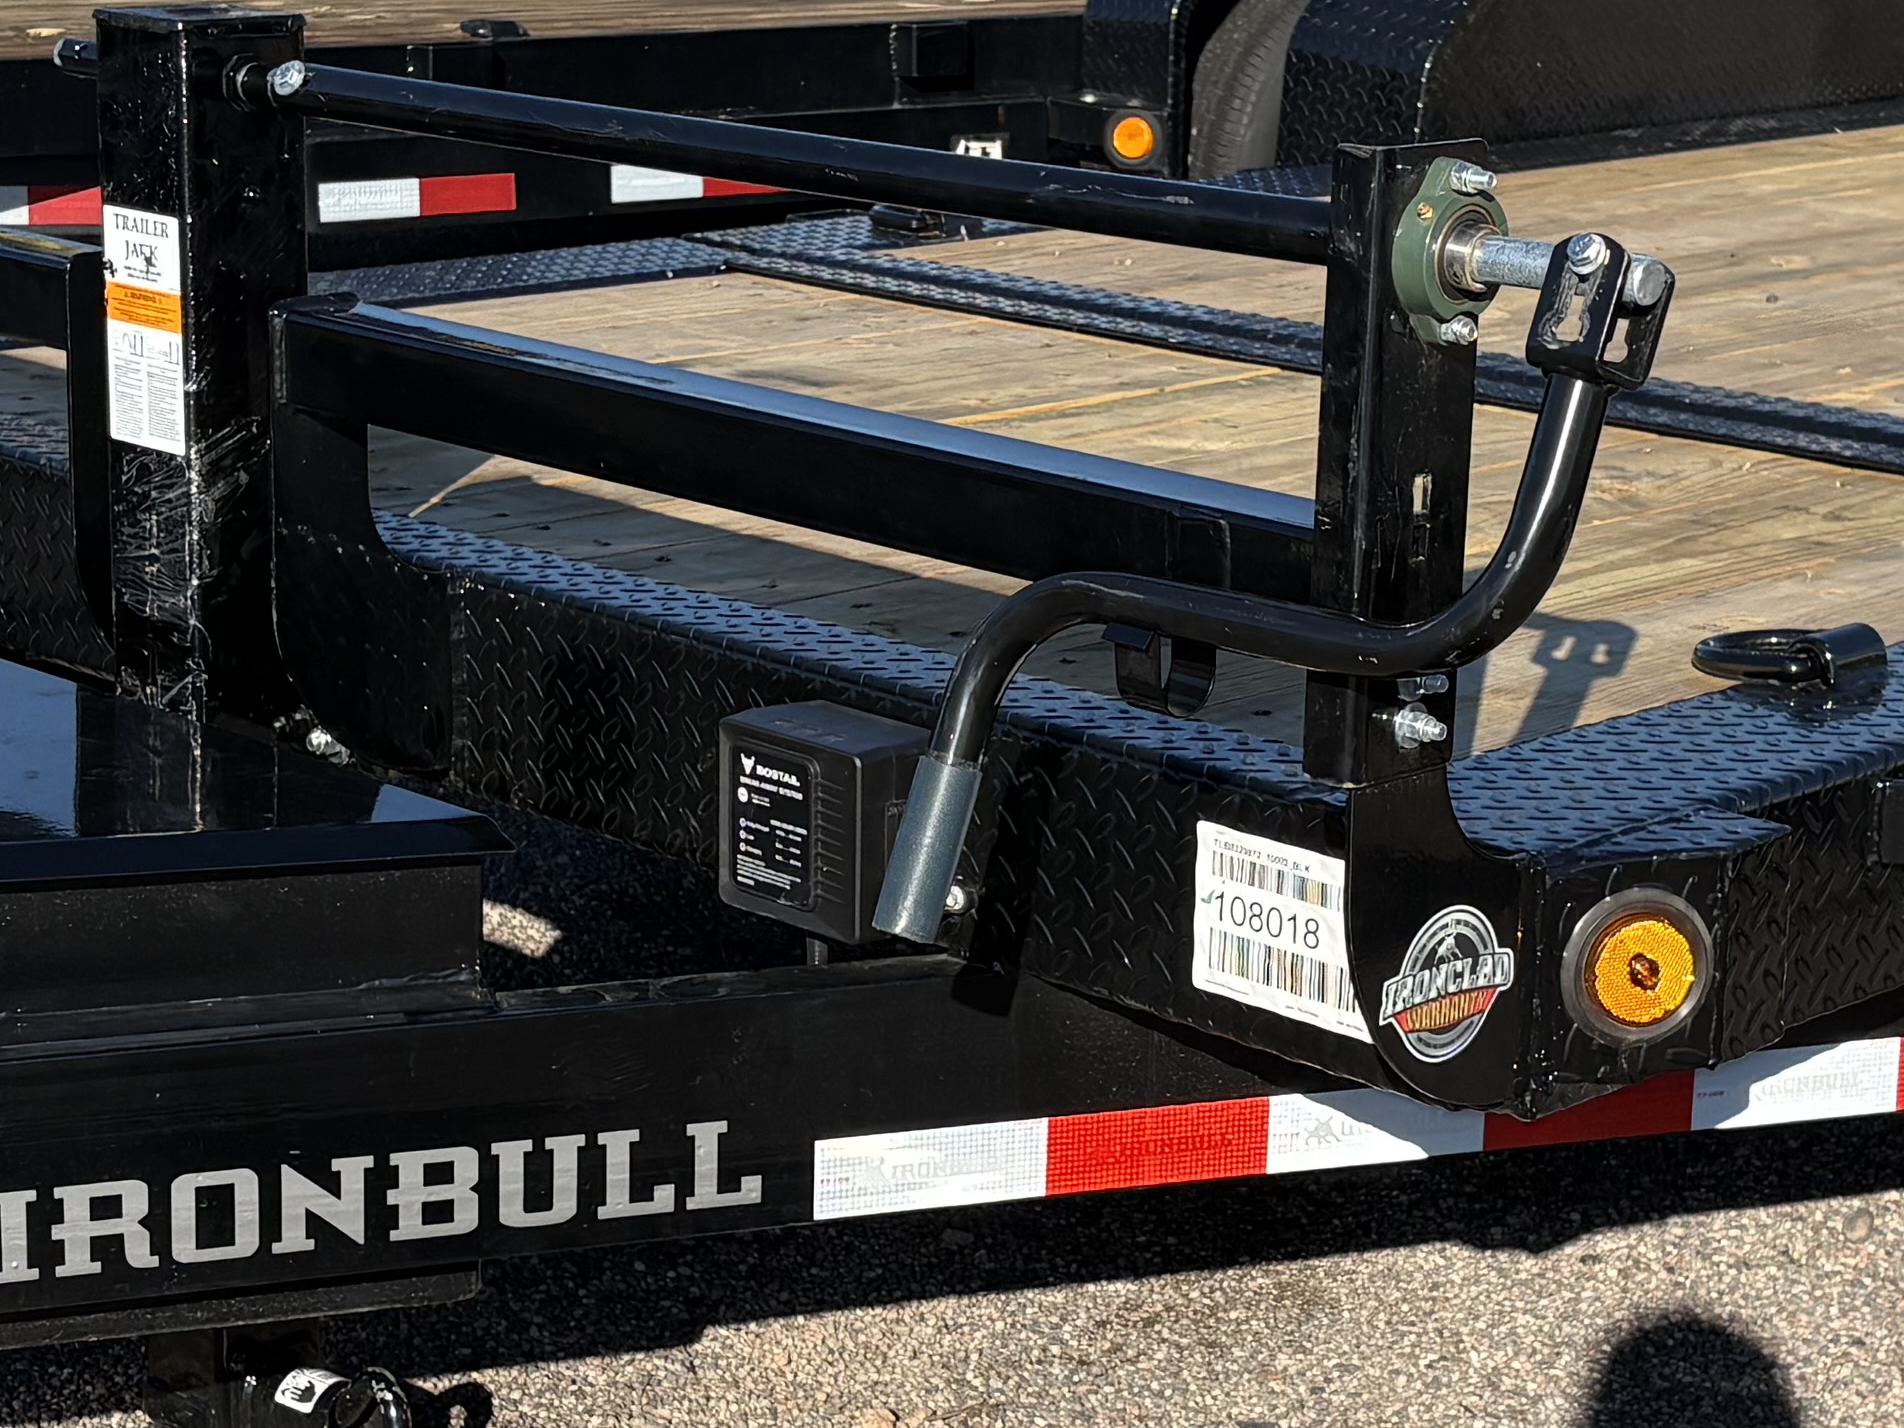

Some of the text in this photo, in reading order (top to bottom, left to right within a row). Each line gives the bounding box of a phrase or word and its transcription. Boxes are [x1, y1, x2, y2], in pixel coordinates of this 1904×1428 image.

[112, 212, 170, 239] TRAILER
[1214, 890, 1320, 950] 108018
[1383, 953, 1510, 1018] IRONCLAD
